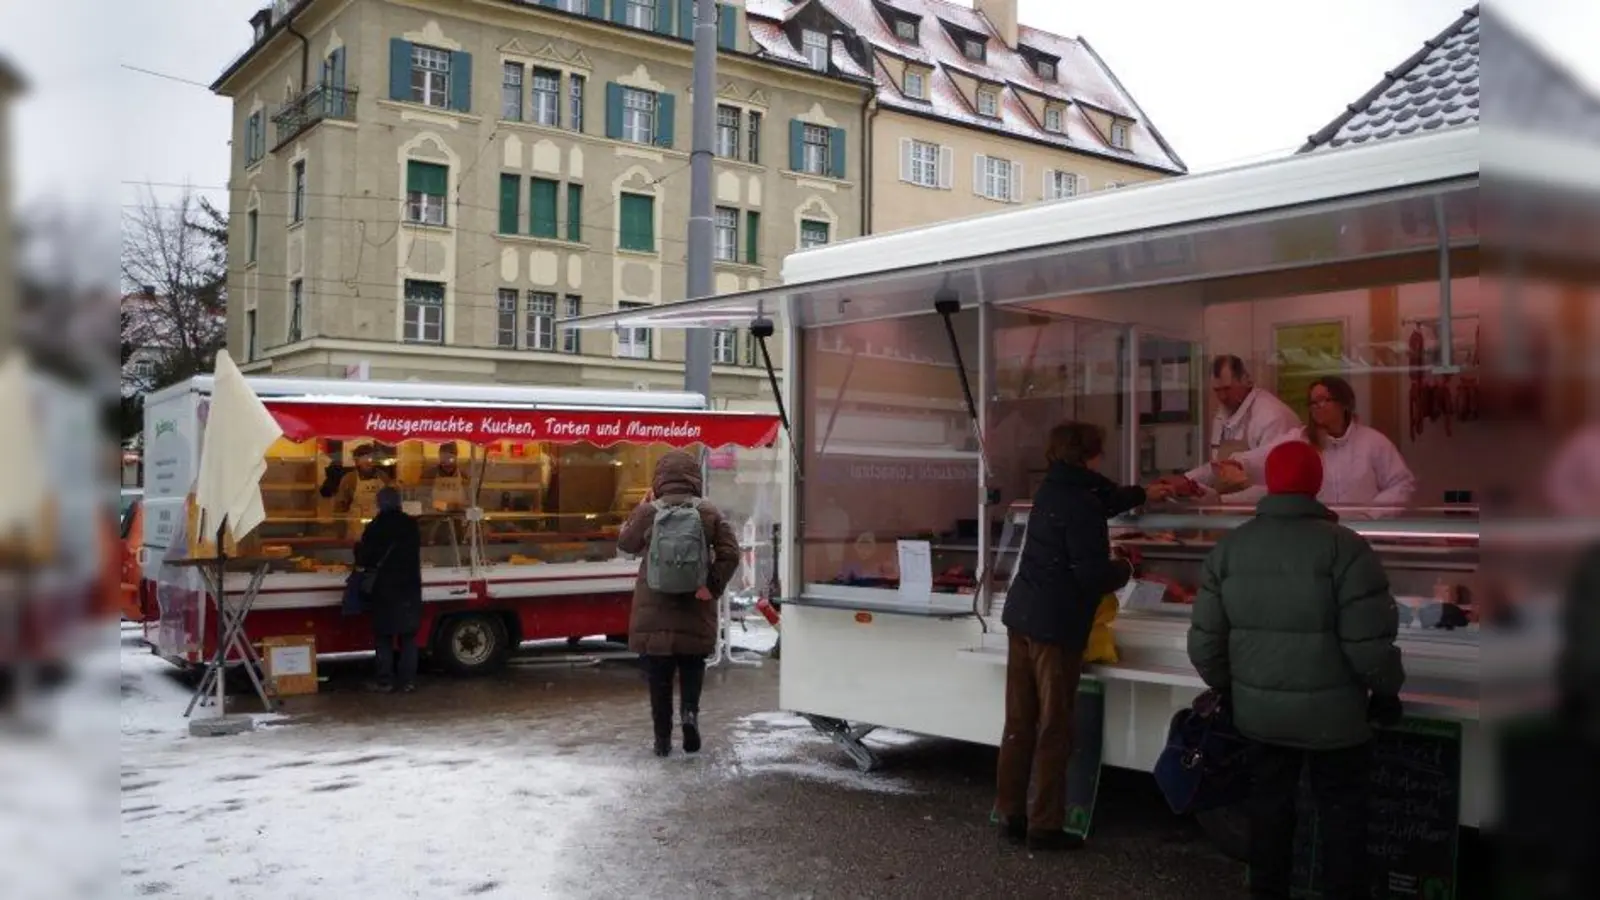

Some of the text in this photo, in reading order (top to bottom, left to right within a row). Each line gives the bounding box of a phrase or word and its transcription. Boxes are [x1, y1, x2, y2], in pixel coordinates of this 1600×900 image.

[366, 411, 701, 437] Hausgemachte Kuchen, Torten und Marmeladen
